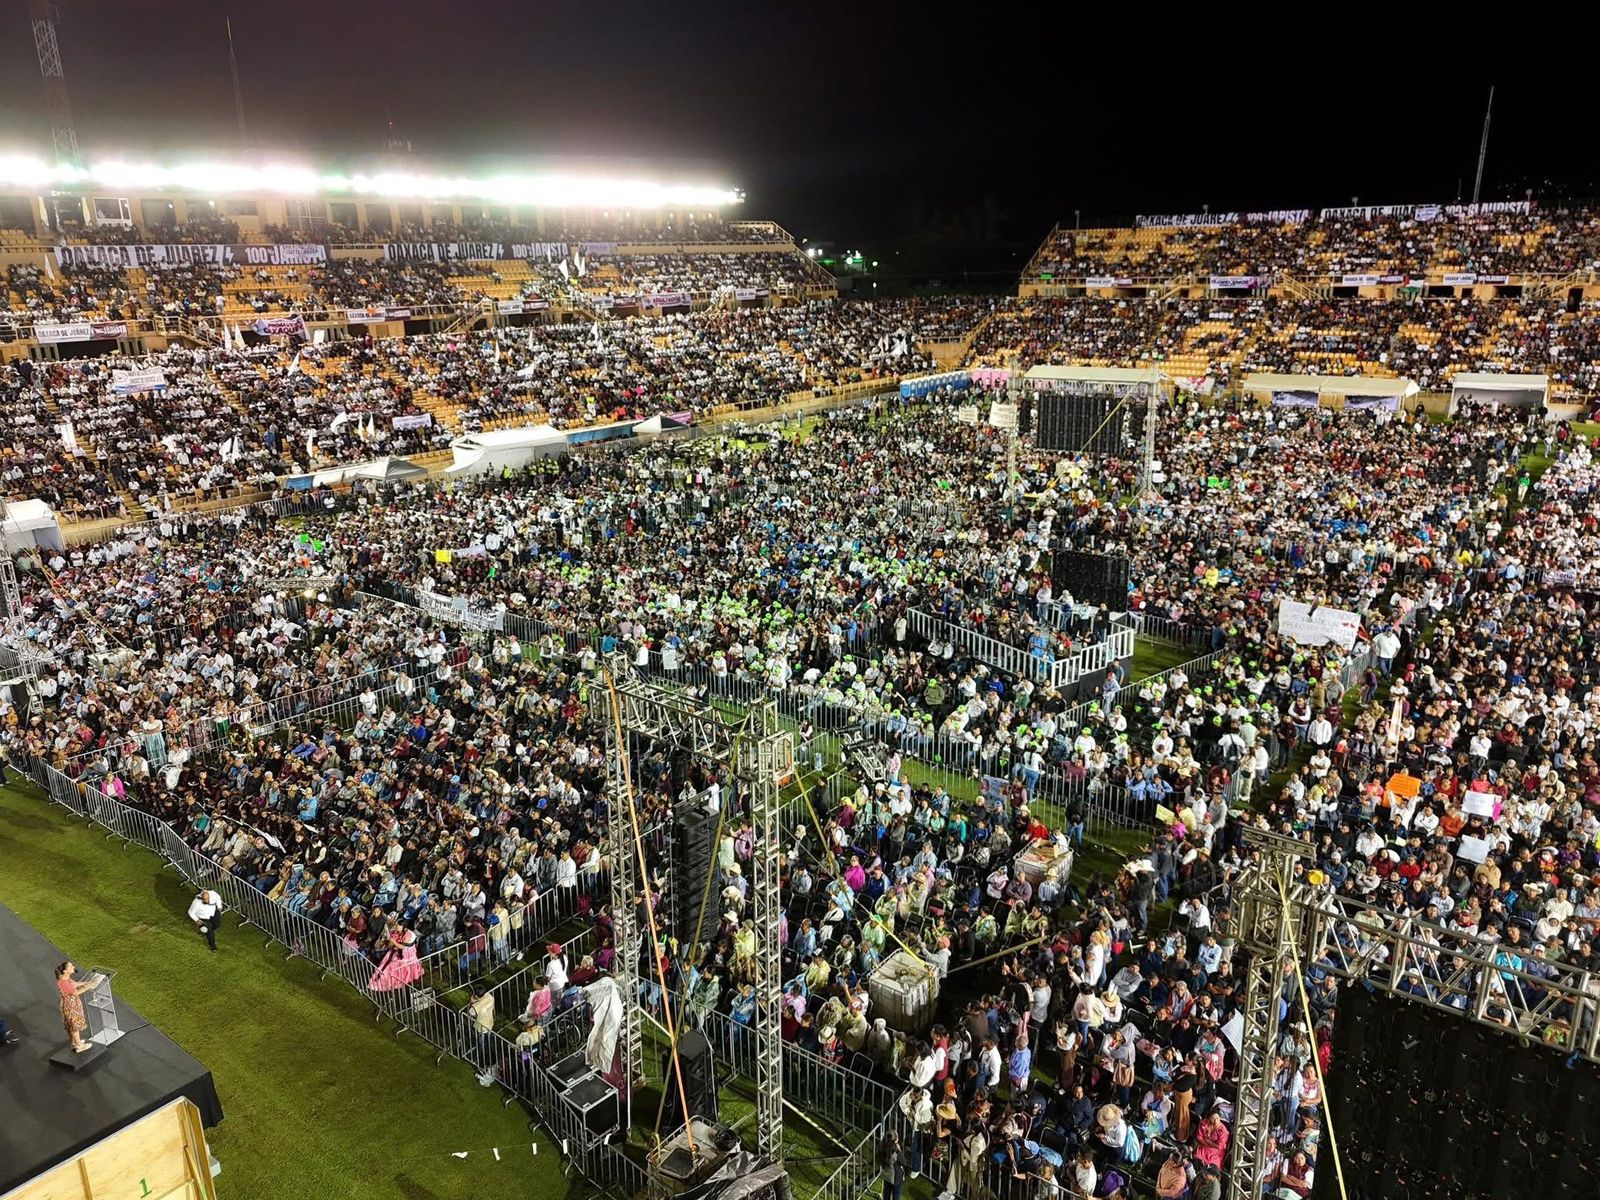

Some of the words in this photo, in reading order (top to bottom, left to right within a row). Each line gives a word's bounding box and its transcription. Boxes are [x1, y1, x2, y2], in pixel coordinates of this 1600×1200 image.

[1137, 215, 1173, 226] OAXACA
[61, 246, 131, 265] OAXACA
[134, 246, 155, 264] DE
[388, 244, 435, 261] OAXACA
[437, 244, 451, 260] DE
[453, 243, 495, 260] JUAREZ
[139, 1178, 152, 1199] 1
